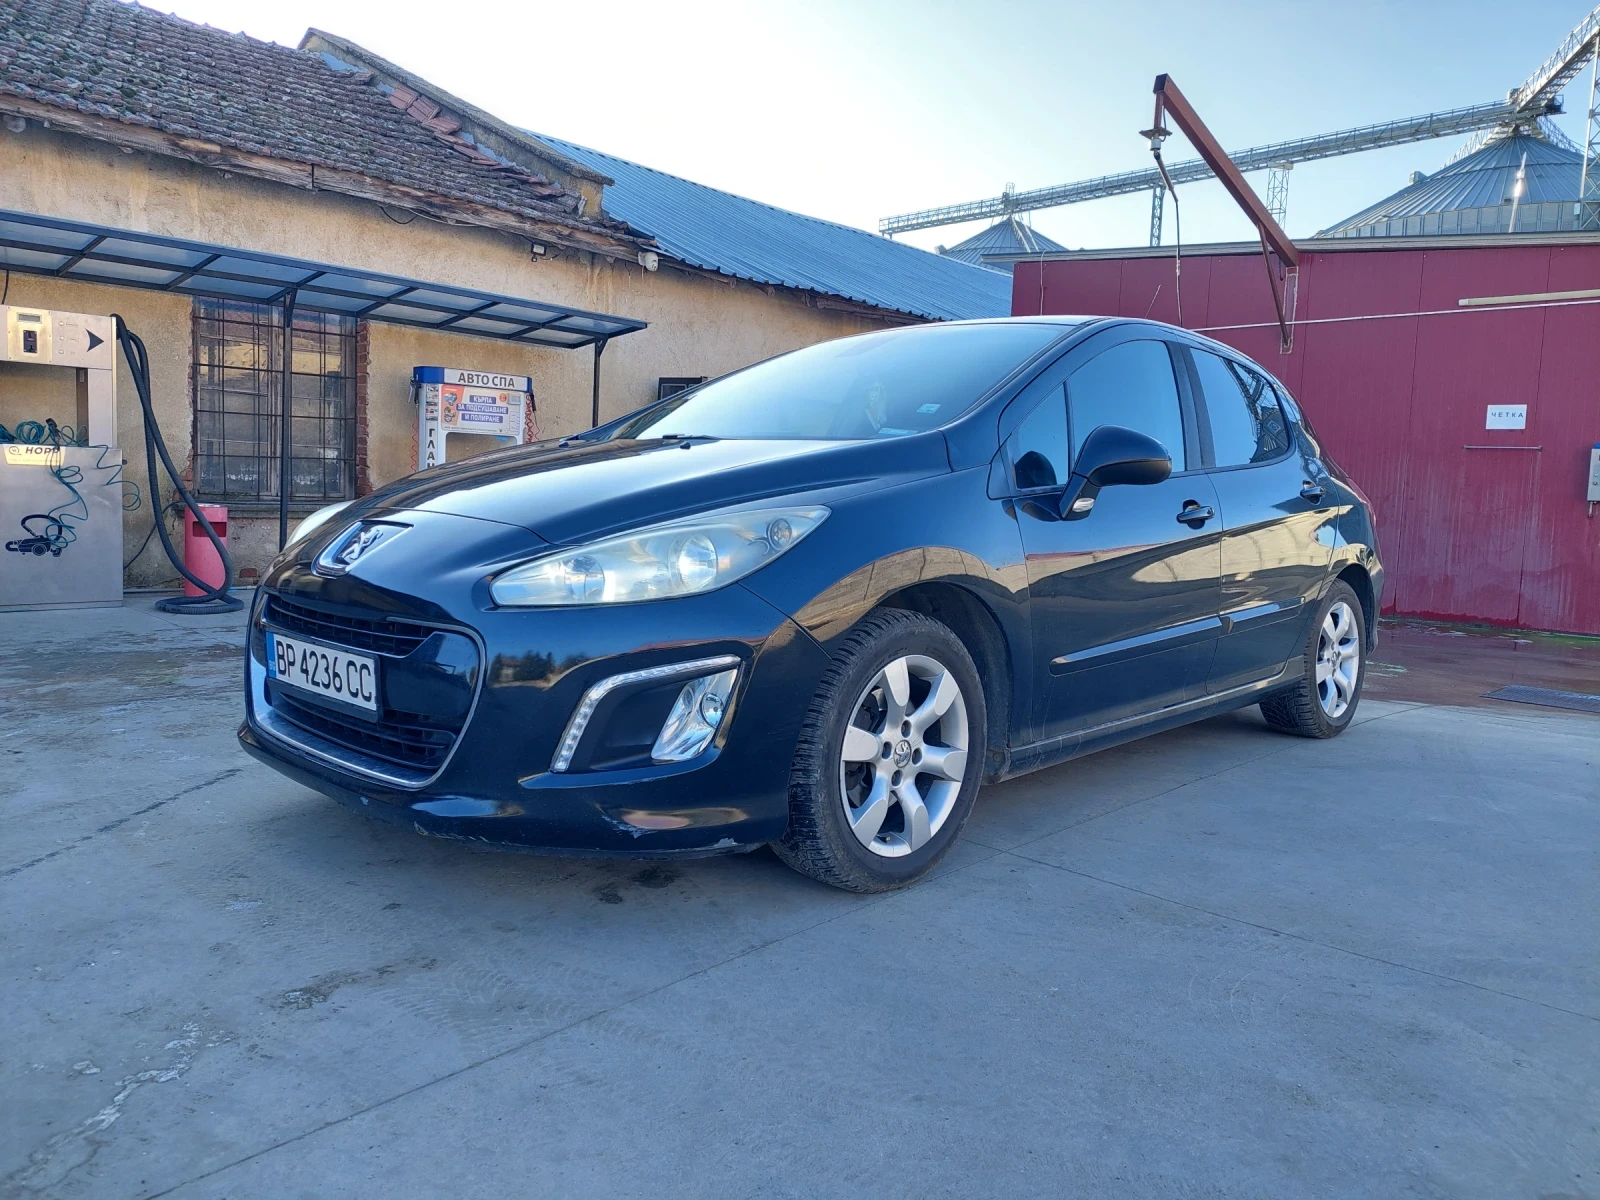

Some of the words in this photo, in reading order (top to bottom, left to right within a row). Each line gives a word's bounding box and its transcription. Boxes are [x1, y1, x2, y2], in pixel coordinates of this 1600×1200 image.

[458, 372, 490, 385] АВТО
[492, 376, 515, 388] СПА
[473, 396, 493, 404] КЪРПА
[466, 405, 507, 414] ПОДСУШАВАНЕ
[470, 414, 500, 423] ПОЛИРАНЕ
[275, 639, 296, 678] BP
[300, 648, 343, 693] 4236
[346, 659, 372, 702] CC
